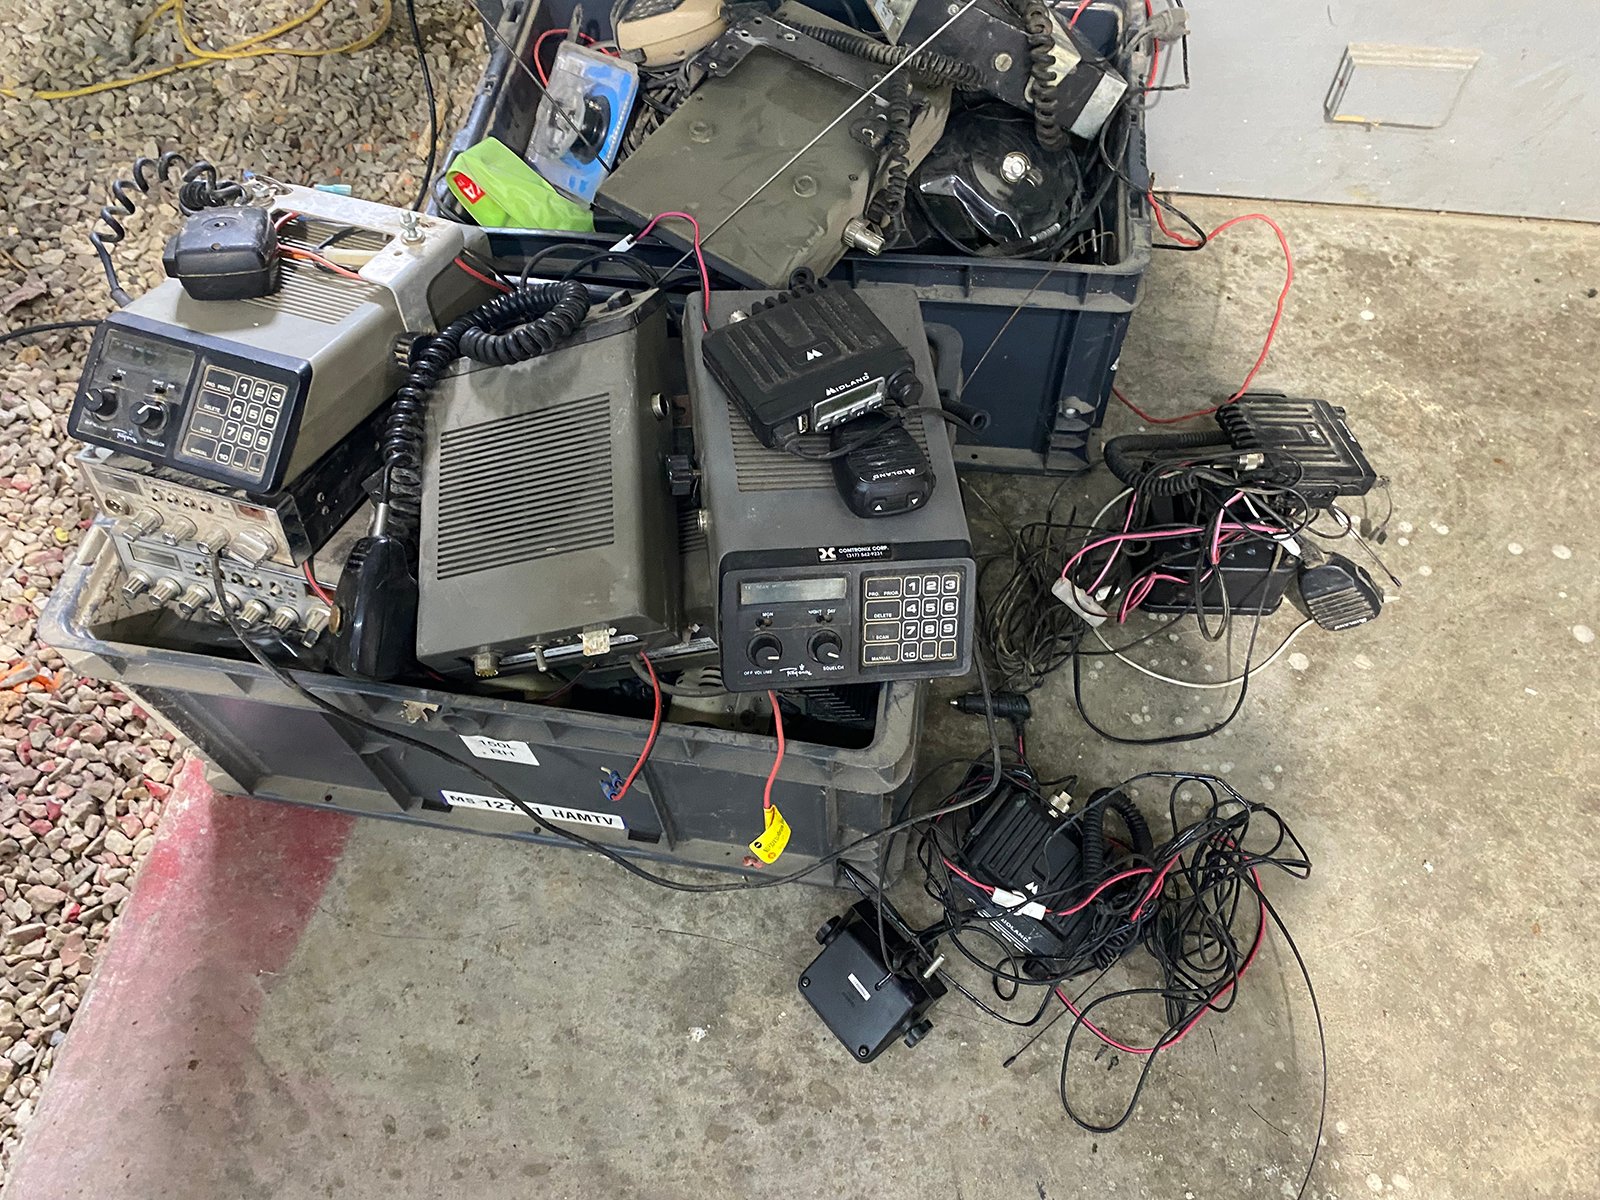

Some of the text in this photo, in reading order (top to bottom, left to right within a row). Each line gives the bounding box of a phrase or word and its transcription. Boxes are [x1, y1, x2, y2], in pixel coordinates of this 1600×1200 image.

[825, 374, 870, 396] MIDLAND
[240, 384, 281, 402] 1 2 3
[232, 405, 274, 424] 4 5 6
[227, 426, 268, 446] 7 8 9
[219, 453, 228, 461] 10
[871, 468, 916, 480] MIDLAND
[909, 580, 956, 591] 1 2 3
[906, 602, 954, 613] 4 5 6
[906, 624, 954, 635] 7 8 9
[482, 799, 542, 815] 1271
[552, 809, 613, 825] HAMTV
